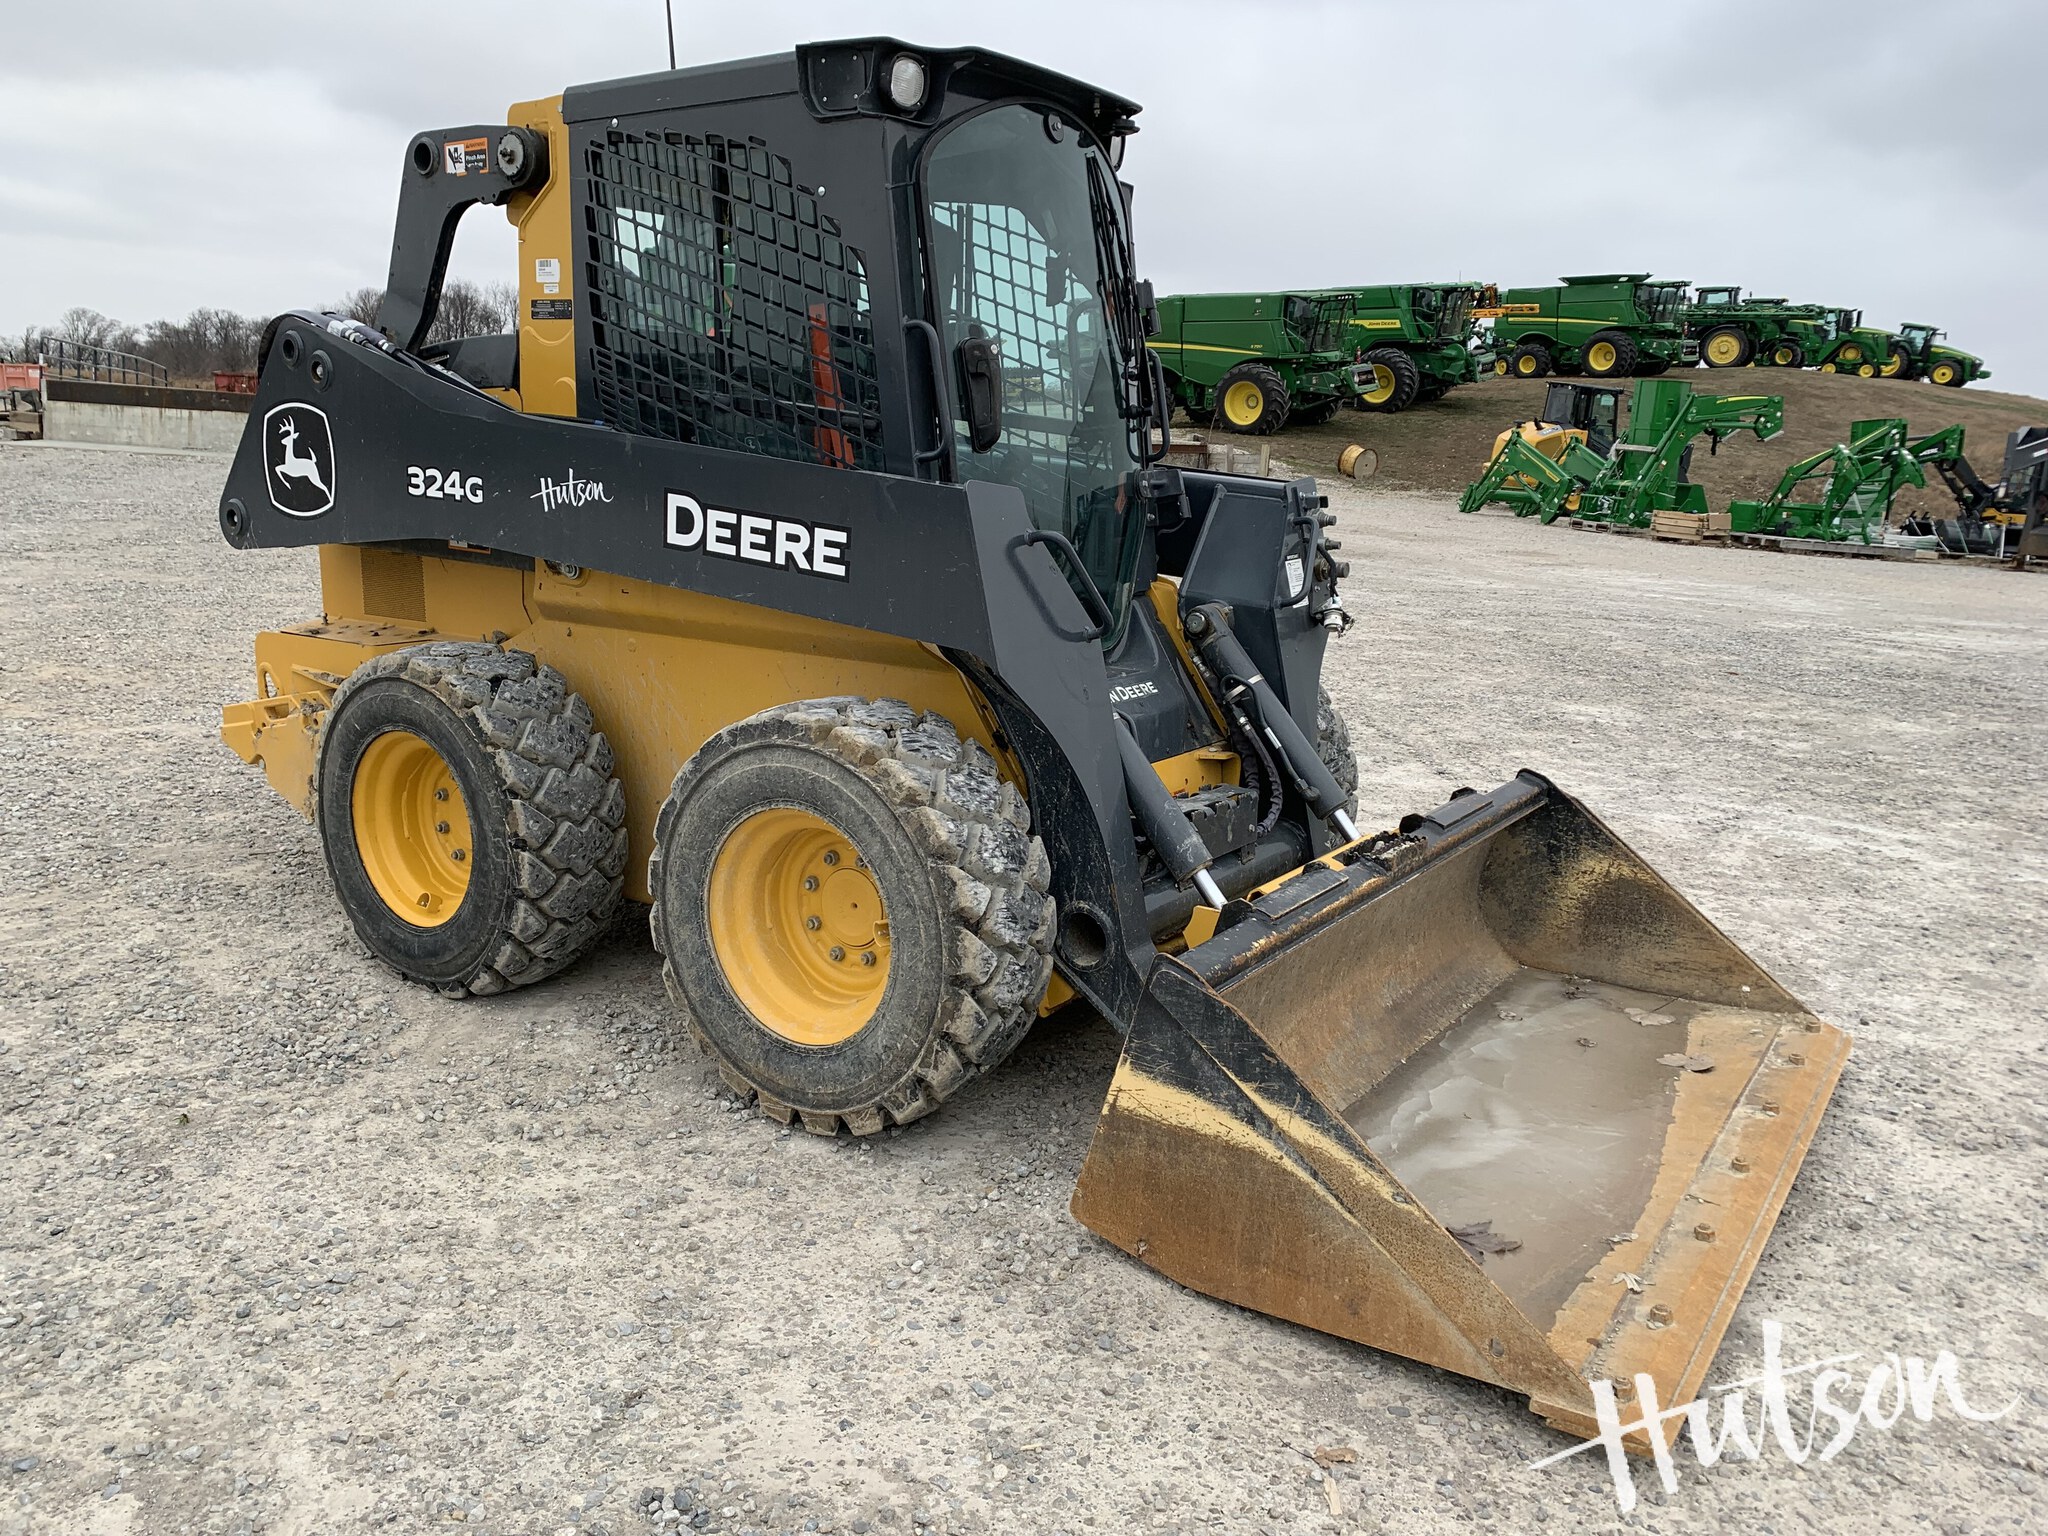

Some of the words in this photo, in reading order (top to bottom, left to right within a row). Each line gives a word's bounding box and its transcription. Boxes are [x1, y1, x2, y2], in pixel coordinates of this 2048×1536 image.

[407, 465, 484, 504] 324G
[530, 467, 614, 512] Hutson
[666, 492, 848, 577] DEERE
[1115, 681, 1158, 700] DEERE
